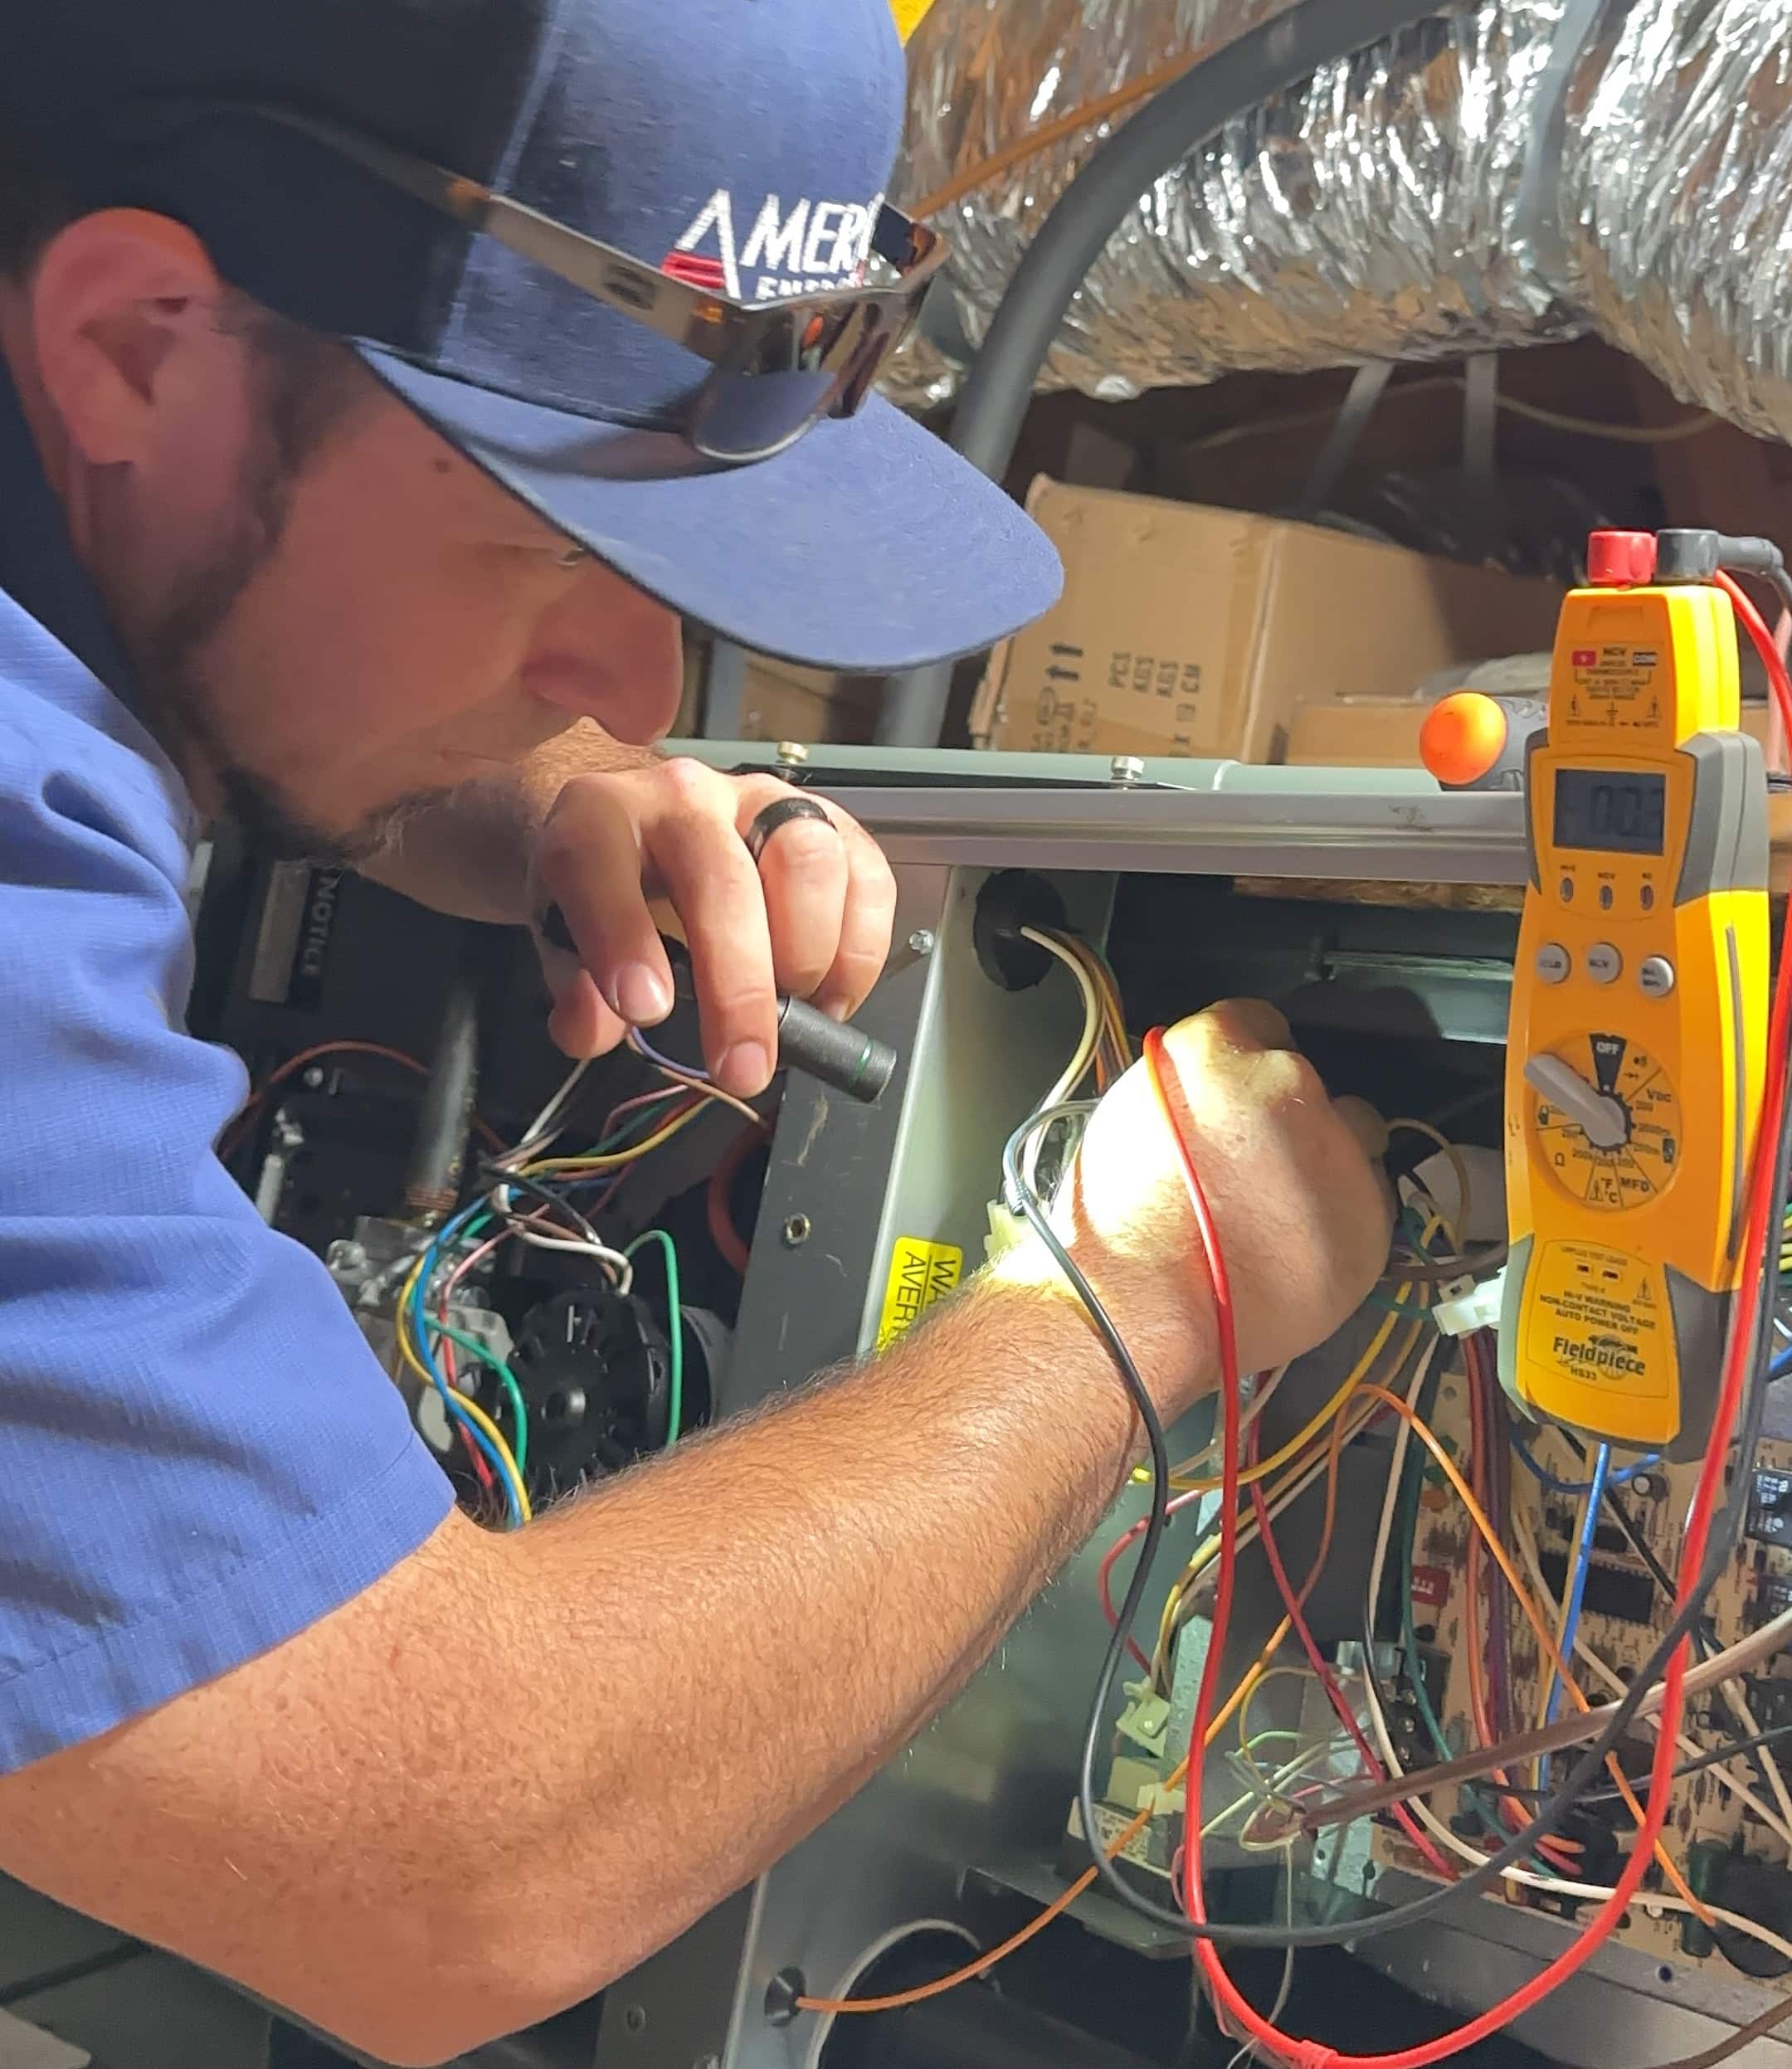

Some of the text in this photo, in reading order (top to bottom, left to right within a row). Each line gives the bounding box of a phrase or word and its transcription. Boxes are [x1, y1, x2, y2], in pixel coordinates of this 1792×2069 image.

[1596, 1042, 1619, 1055] OFF
[1620, 1176, 1650, 1193] MFD
[892, 1250, 927, 1331] AVER
[1540, 1294, 1655, 1330] NON-CONTACT VOLTAGE
[1585, 1293, 1630, 1313] WARNING
[1555, 1309, 1581, 1321] AUTO
[1585, 1316, 1618, 1330] POWER
[1553, 1336, 1645, 1375] Fieldpiece
